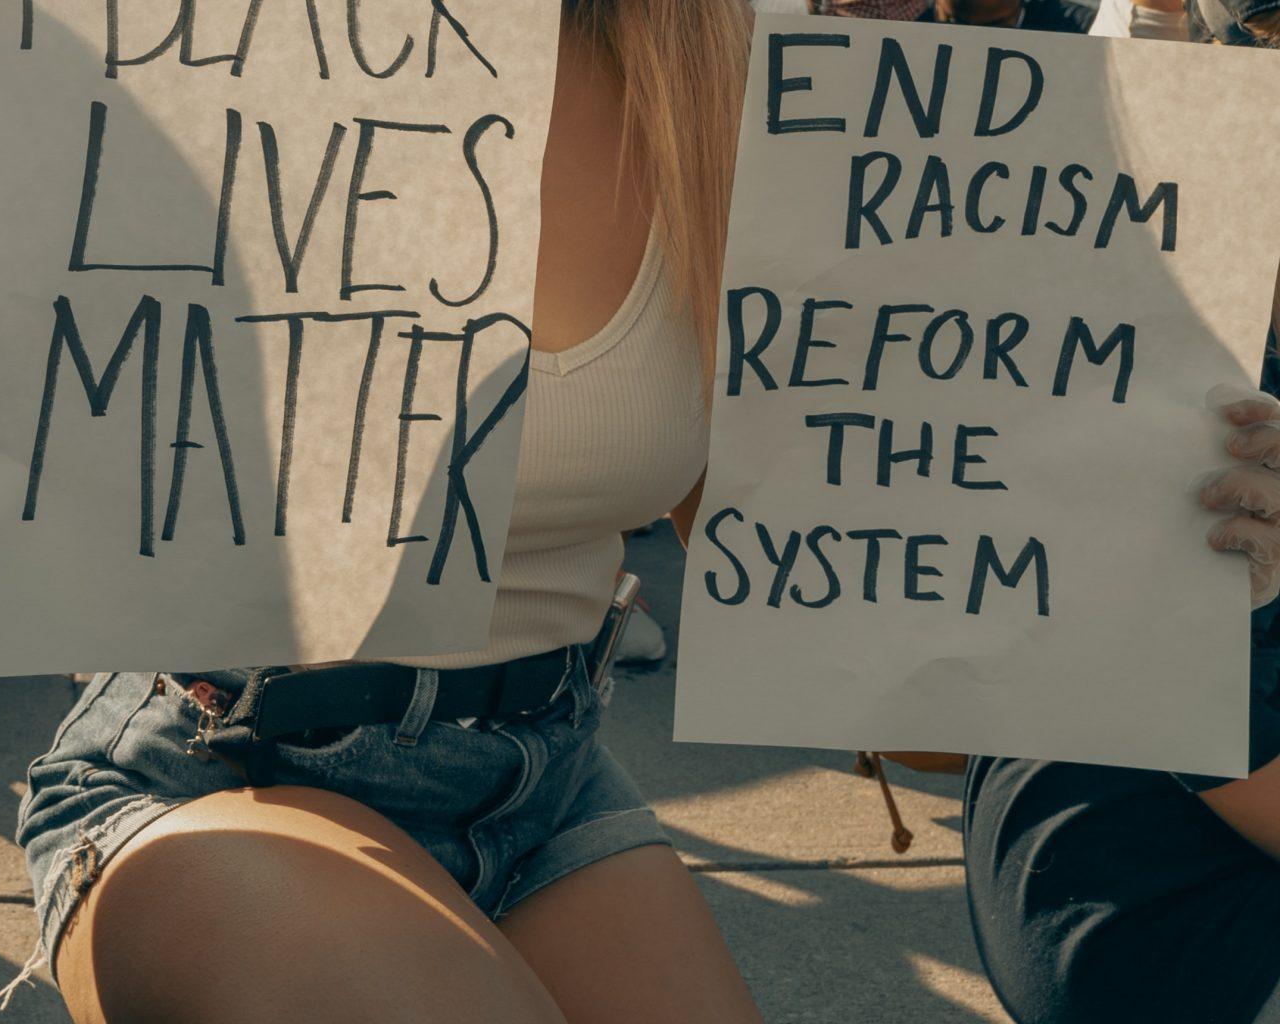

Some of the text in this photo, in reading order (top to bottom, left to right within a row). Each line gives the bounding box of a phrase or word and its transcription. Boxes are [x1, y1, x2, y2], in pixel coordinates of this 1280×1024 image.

[766, 32, 1046, 139] END
[67, 100, 516, 308] LIVES
[844, 150, 1180, 252] RACISM
[726, 285, 1137, 404] REFORM
[21, 294, 533, 586] MATTER
[805, 412, 1010, 491] THE
[704, 507, 1051, 617] SYSTEM
